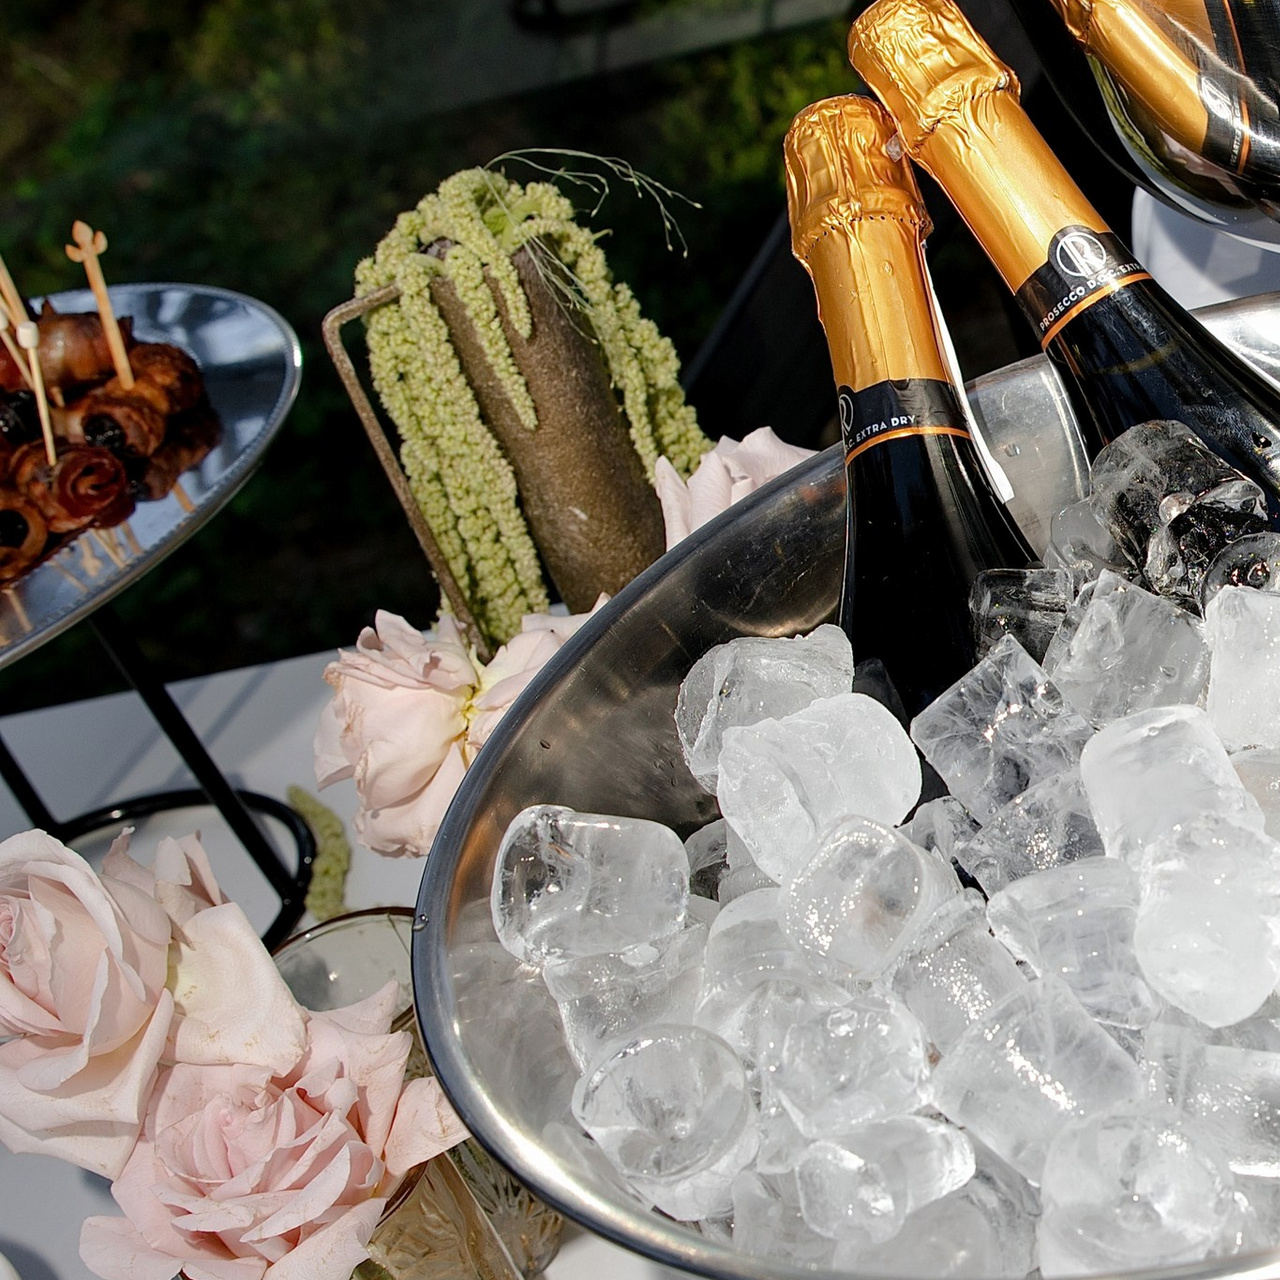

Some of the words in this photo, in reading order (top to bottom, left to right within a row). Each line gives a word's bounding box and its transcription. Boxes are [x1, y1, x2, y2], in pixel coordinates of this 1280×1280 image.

[1039, 287, 1085, 332] PROSECCO
[855, 420, 888, 442] EXTRA
[890, 413, 917, 427] DRY
